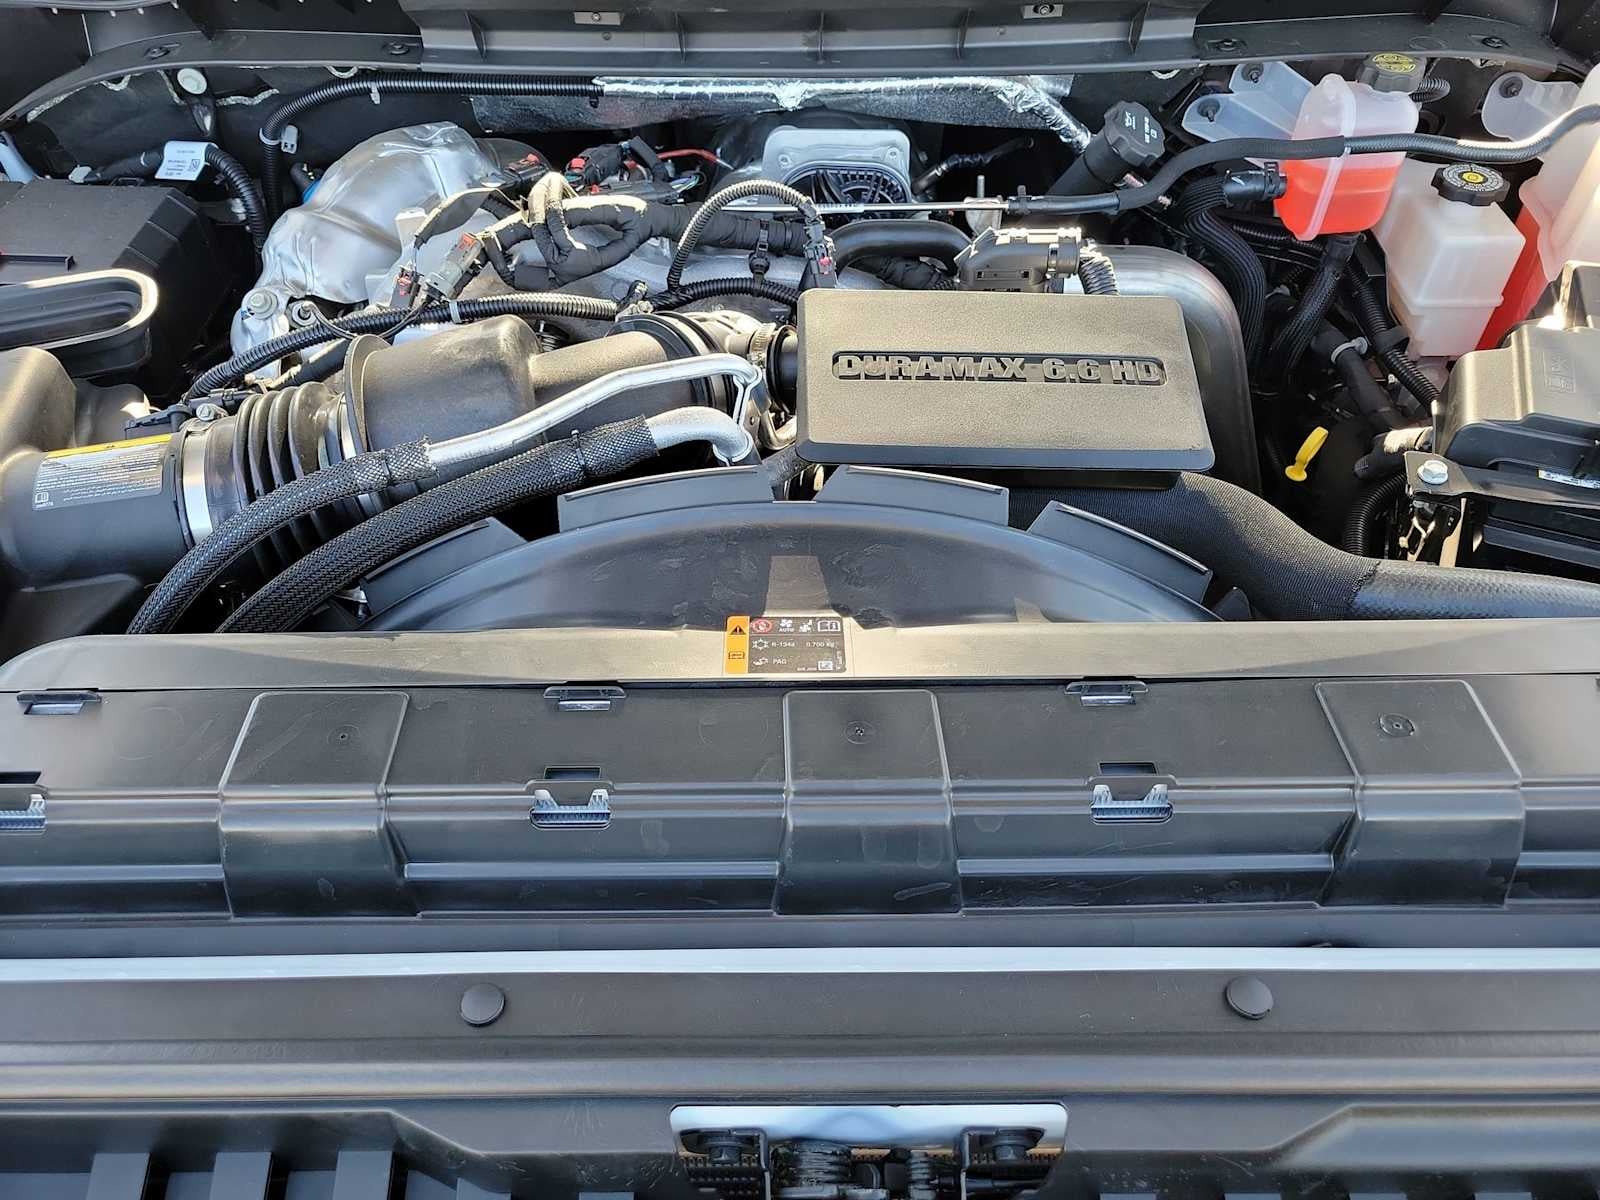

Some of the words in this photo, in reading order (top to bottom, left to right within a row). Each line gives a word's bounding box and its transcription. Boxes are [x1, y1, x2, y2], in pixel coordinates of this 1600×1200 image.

[837, 355, 1026, 381] DURAMAX
[1042, 358, 1101, 383] 6.6
[1109, 359, 1162, 385] HD
